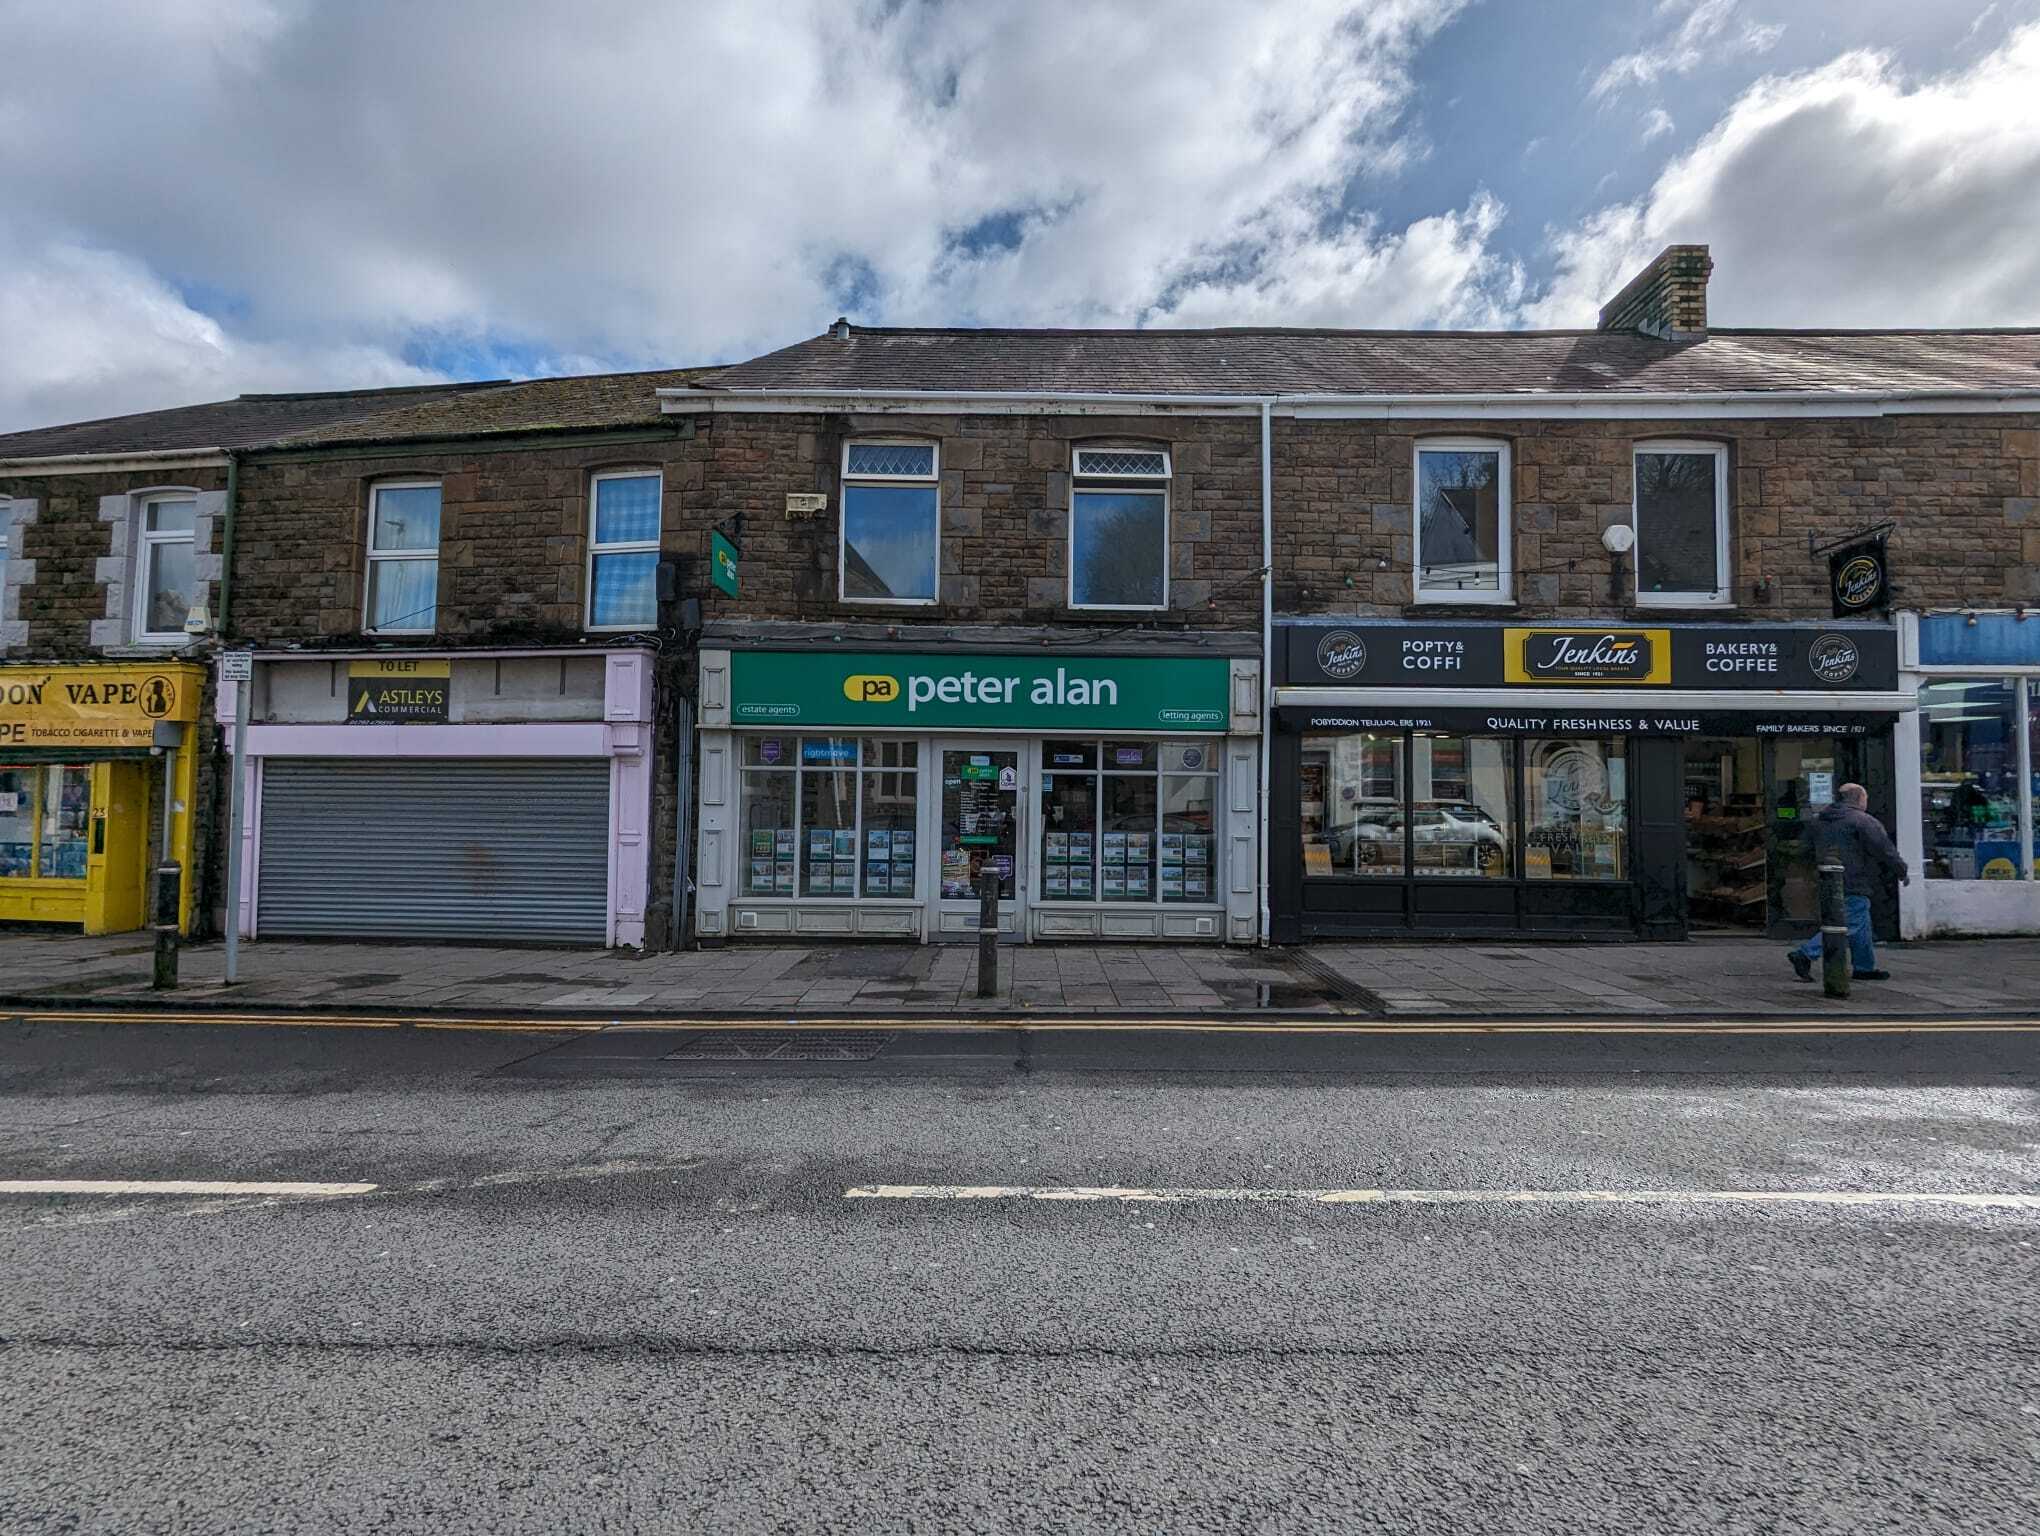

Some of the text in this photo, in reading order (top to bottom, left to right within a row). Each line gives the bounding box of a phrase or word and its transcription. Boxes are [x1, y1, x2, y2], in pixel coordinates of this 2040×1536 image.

[1322, 645, 1363, 668] Jenkins
[1538, 635, 1638, 669] Jenkins
[379, 661, 419, 672] TO LET
[1402, 656, 1461, 669] COFFI
[1706, 658, 1777, 672] COFFEE
[1815, 649, 1856, 672] Jenkins
[0, 684, 138, 705] ON VAPE
[863, 679, 890, 700] pa
[908, 667, 1118, 711] peter alan
[379, 690, 443, 704] ASTLEYS
[378, 706, 442, 714] COMMERCIAL
[742, 705, 796, 716] estate agents
[1163, 711, 1219, 721] letting agents
[1487, 717, 1700, 731] QUALITY FRESHNESS & VALUE
[1756, 724, 1785, 733] FAMILY
[1787, 724, 1819, 733] BAKERS
[1823, 725, 1848, 733] SINCE
[32, 728, 70, 737] TOBACCO
[73, 728, 119, 737] CIGARETTE
[803, 748, 850, 759] rightmove
